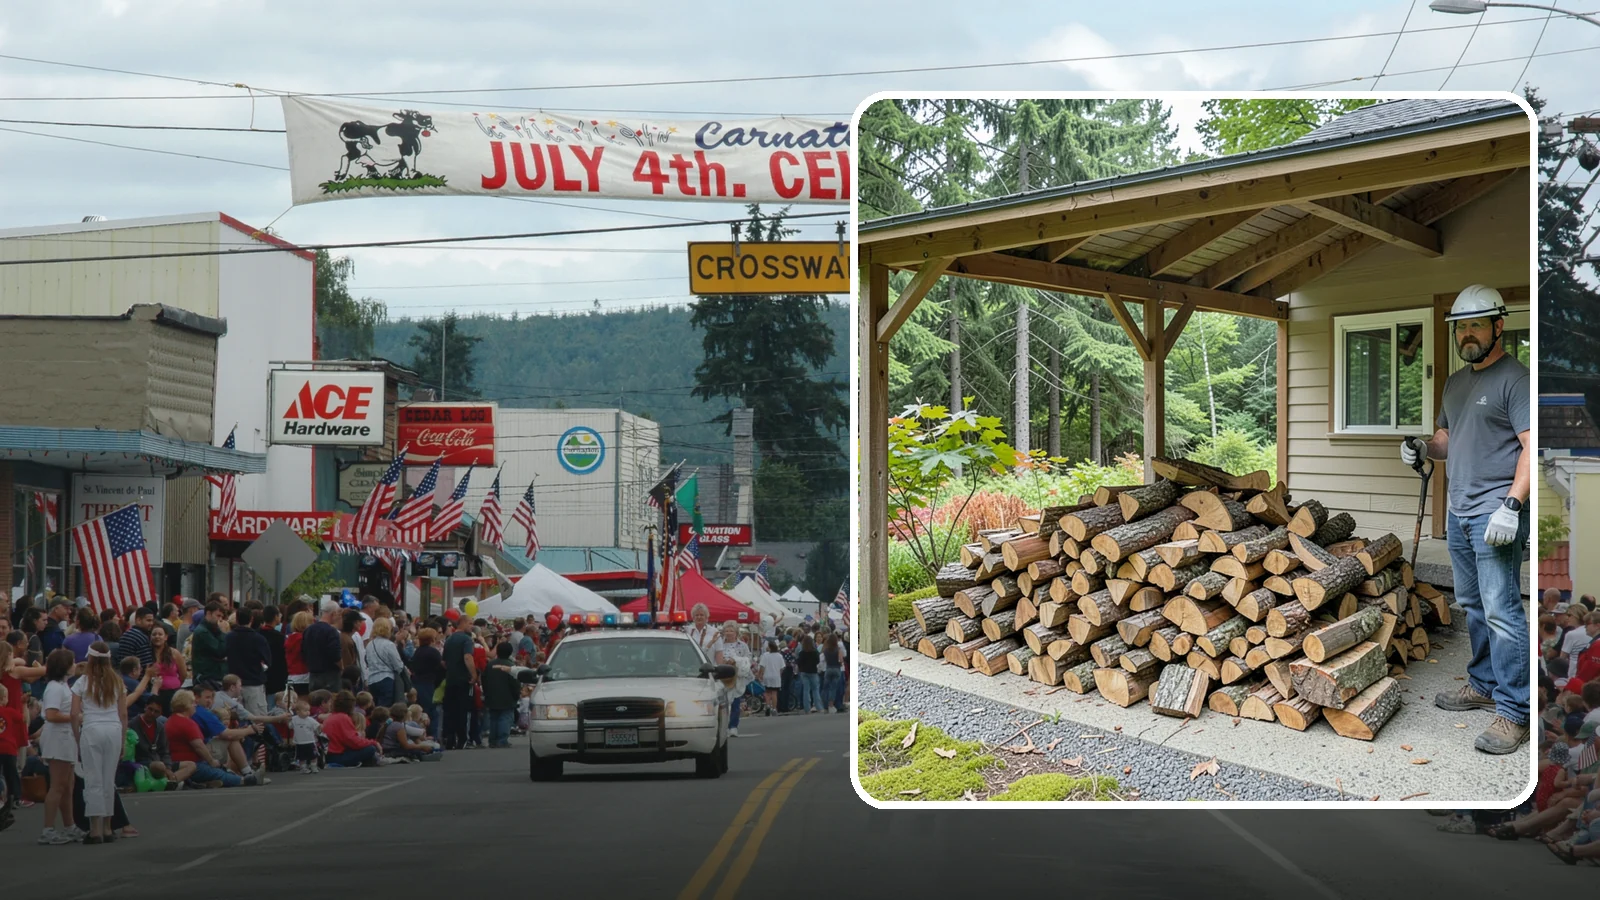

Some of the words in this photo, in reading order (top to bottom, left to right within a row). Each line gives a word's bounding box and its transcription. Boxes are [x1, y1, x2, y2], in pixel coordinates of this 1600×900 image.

[481, 141, 605, 192] JULY
[632, 149, 747, 198] 4th.
[696, 254, 850, 280] CROSSWA
[283, 380, 373, 420] ACE
[405, 409, 452, 422] CEDAR
[283, 421, 370, 437] Hardware
[417, 428, 476, 447] Coca-Cola
[354, 467, 386, 481] Simpl
[95, 485, 124, 495] Vincent
[126, 486, 136, 495] de
[137, 486, 155, 495] Paul
[688, 526, 741, 535] CRNATION
[699, 535, 730, 543] GLASS
